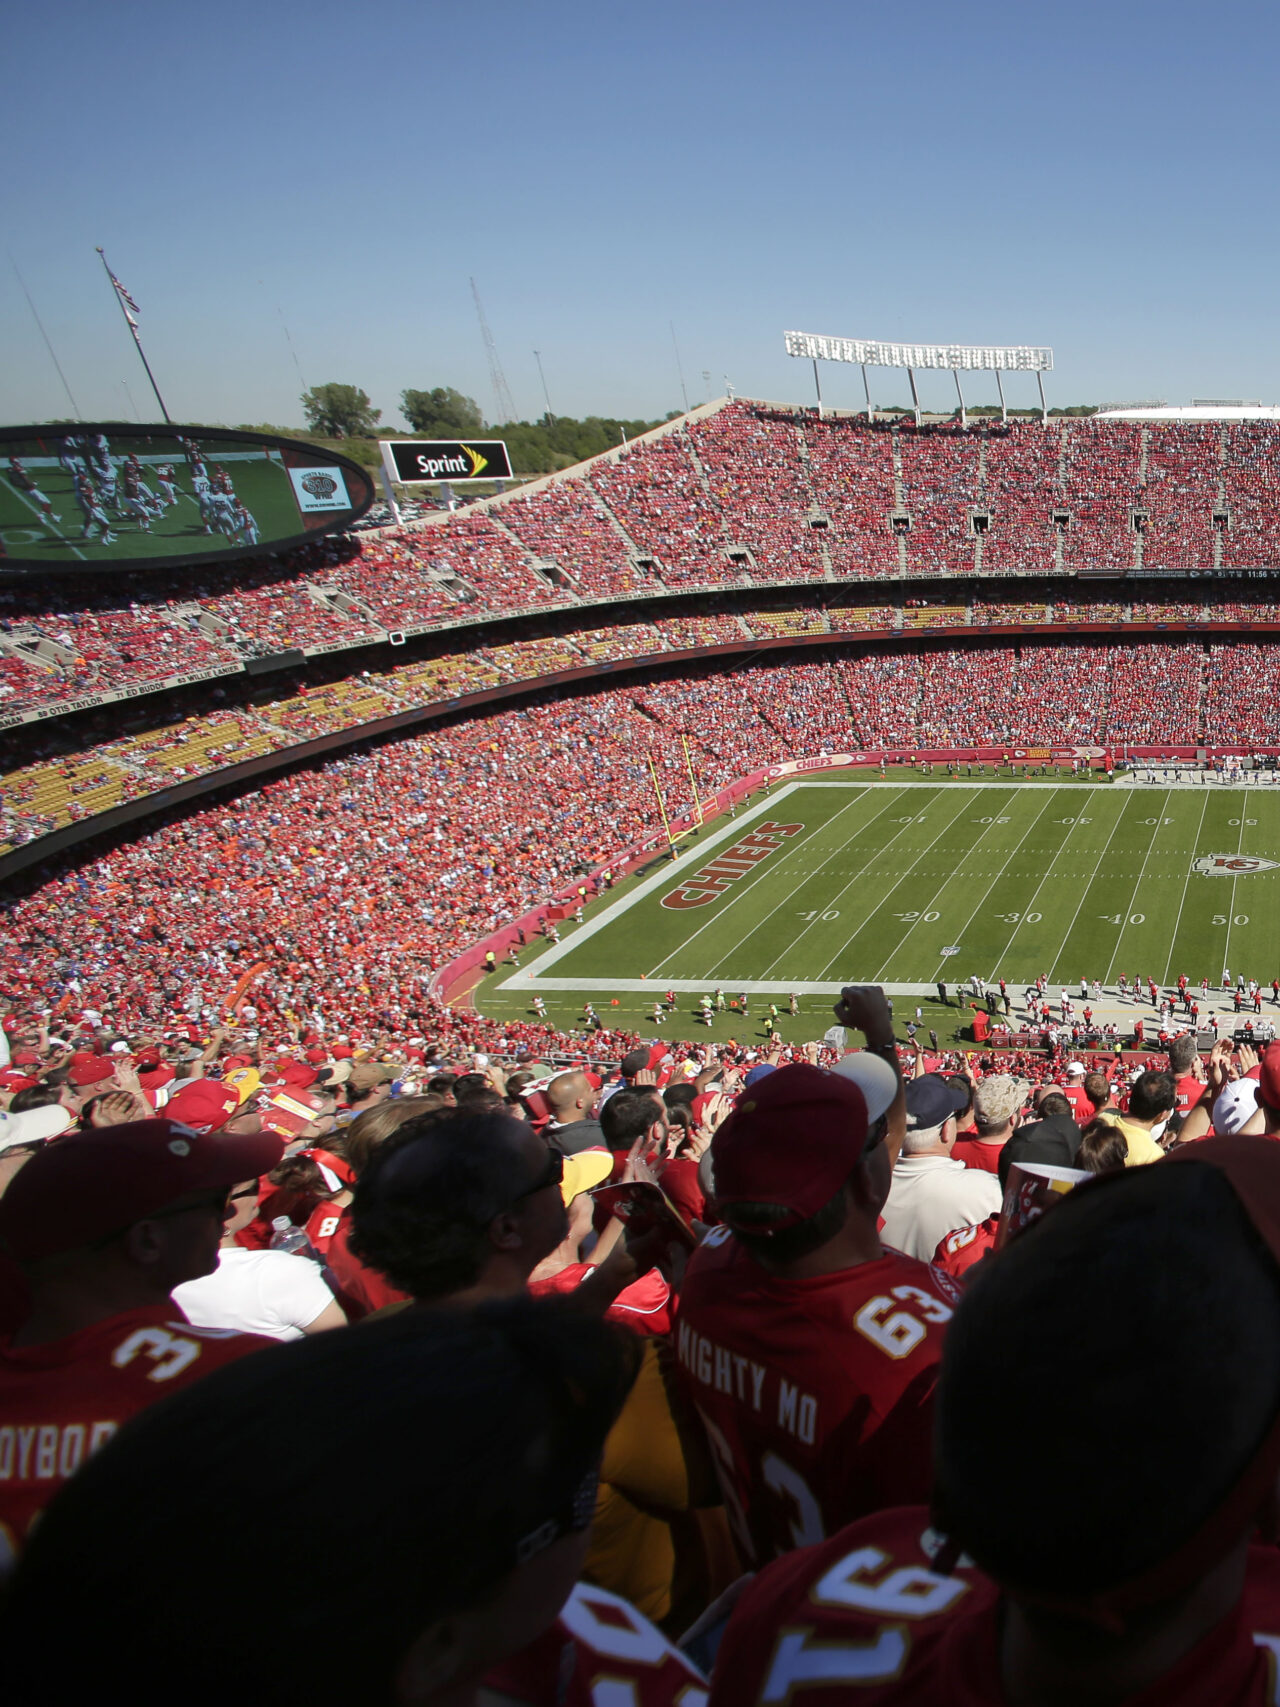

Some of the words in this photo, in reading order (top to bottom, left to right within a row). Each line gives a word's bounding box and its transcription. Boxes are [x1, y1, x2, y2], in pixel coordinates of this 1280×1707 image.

[416, 454, 469, 477] Sprint
[1248, 570, 1268, 578] 11:56
[186, 670, 213, 684] WILLIE
[213, 664, 240, 679] LANIER
[126, 687, 138, 698] ED
[138, 681, 168, 695] BUDDE
[49, 703, 72, 717] OTIS
[71, 695, 105, 711] TAYLOR
[796, 757, 833, 770] CHIEFS
[660, 820, 805, 910] CHIEFS
[803, 910, 841, 921] 10
[899, 911, 941, 922] 20
[1002, 912, 1042, 924] 30
[1106, 913, 1146, 925] 40
[1211, 914, 1250, 926] 50
[853, 1285, 954, 1361] 63
[677, 1318, 767, 1412] MIGHTY
[777, 1377, 818, 1446] MO
